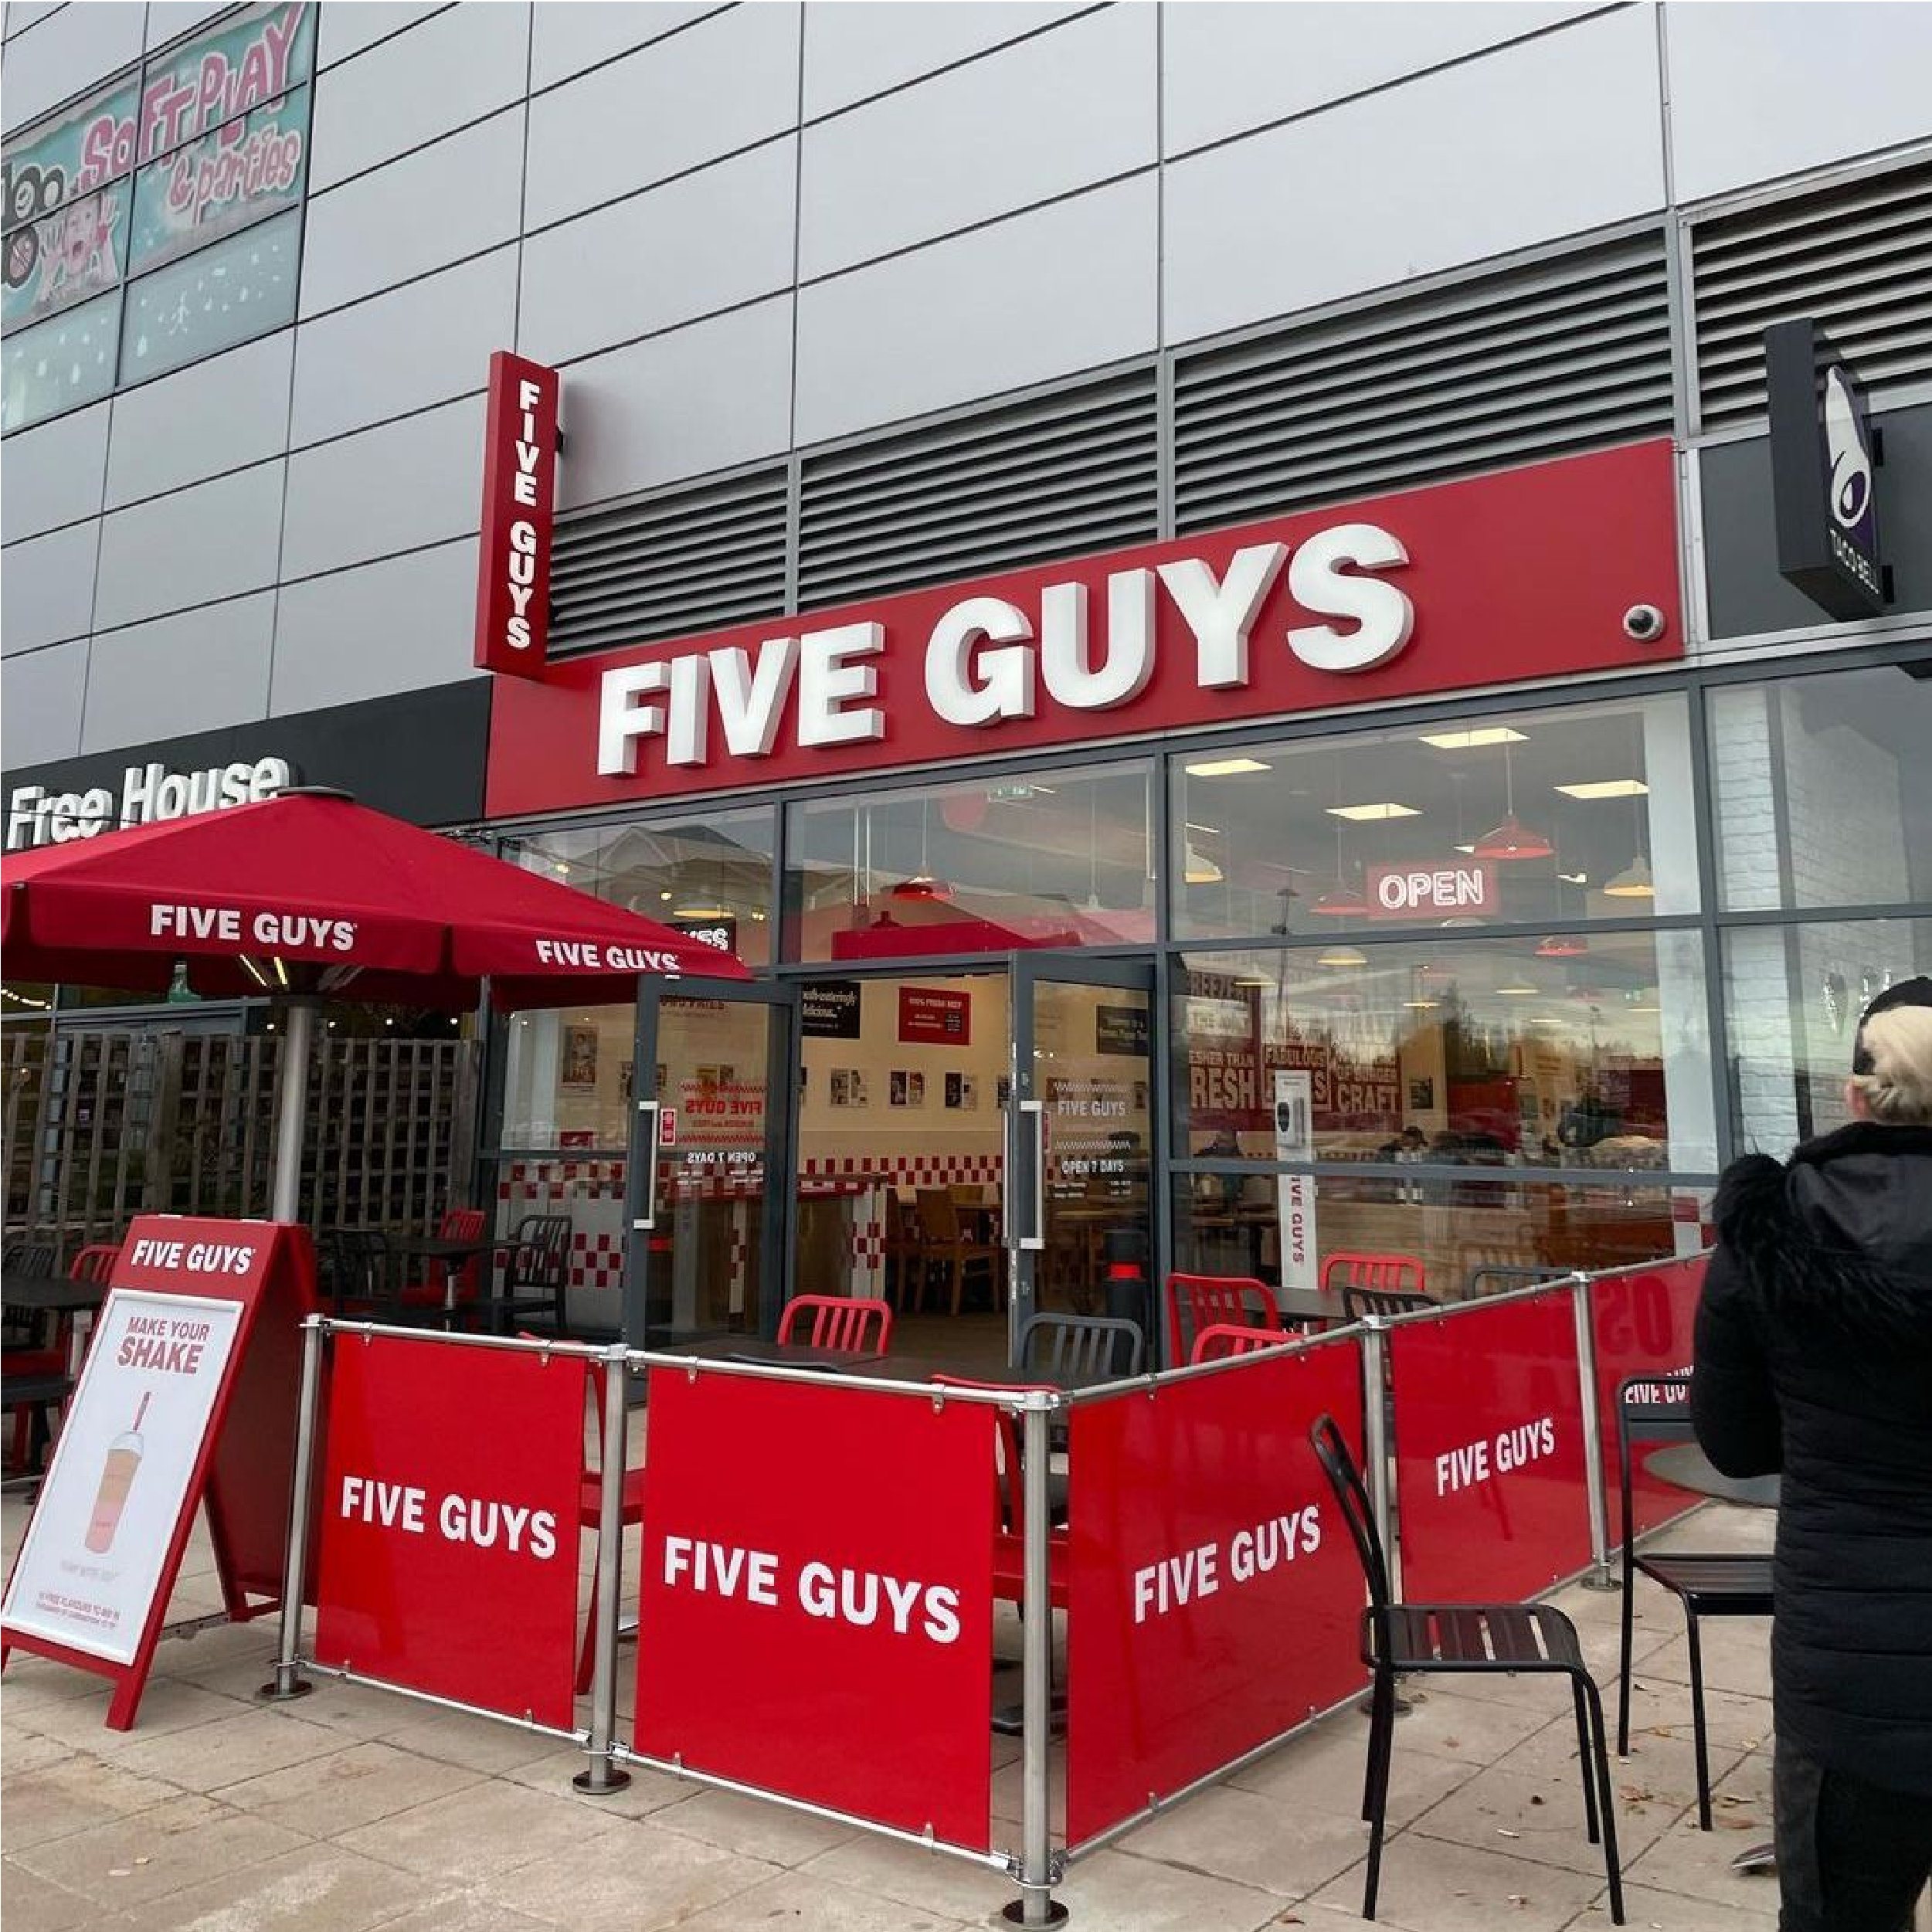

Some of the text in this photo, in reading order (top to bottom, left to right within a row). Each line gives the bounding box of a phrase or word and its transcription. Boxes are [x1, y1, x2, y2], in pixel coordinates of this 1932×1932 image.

[507, 380, 540, 649] FIVE GUYS
[597, 524, 1414, 776] FIVE GUYS
[7, 757, 290, 849] Free House
[1378, 869, 1483, 910] OPEN
[151, 905, 355, 952] FIVE GUYS
[535, 939, 681, 971] FIVE GUYS
[1058, 1100, 1126, 1116] FIVE GUYS
[1190, 1067, 1255, 1110] RESH
[1337, 1084, 1398, 1113] CRAFT
[1061, 1160, 1089, 1175] OPEN
[1100, 1160, 1125, 1173] DAYS
[1290, 1174, 1305, 1263] IVE GUYS
[131, 1239, 254, 1275] FIVE GUYS
[126, 1316, 210, 1342] MAKE YOUR
[117, 1336, 204, 1374] SHAKE
[1438, 1418, 1555, 1496] FIVE GUYS
[341, 1476, 557, 1560] FIVE GUYS
[1135, 1506, 1322, 1623] FIVE GUYS
[664, 1536, 960, 1645] FIVE GUYS
